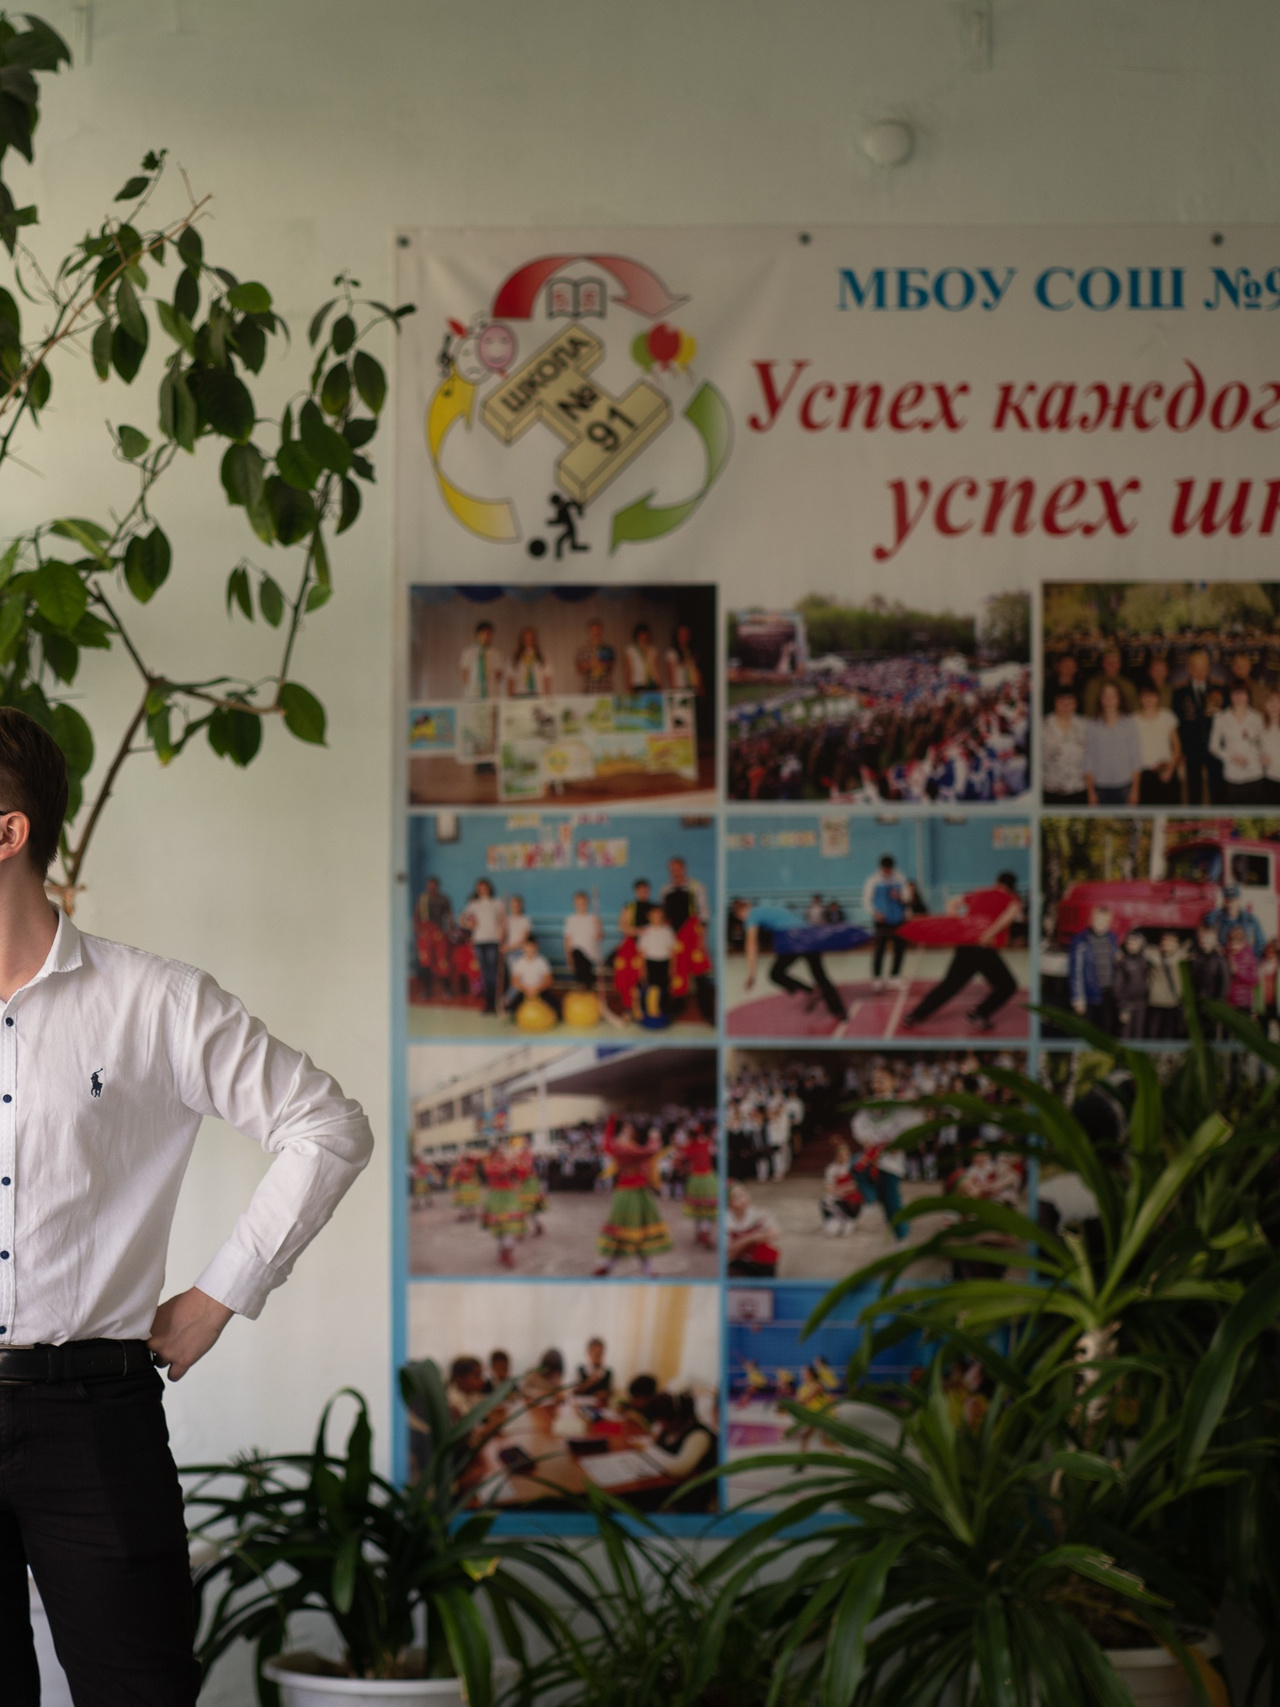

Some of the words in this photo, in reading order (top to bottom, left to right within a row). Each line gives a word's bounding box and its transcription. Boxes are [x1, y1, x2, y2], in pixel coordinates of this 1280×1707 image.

[836, 266, 1018, 312] МБОУ
[1033, 266, 1187, 312] СОШ
[499, 334, 591, 413] ШКОЛА
[557, 384, 601, 422] №
[747, 357, 970, 434] Успех
[586, 405, 637, 452] 91
[871, 474, 1142, 564] успех
